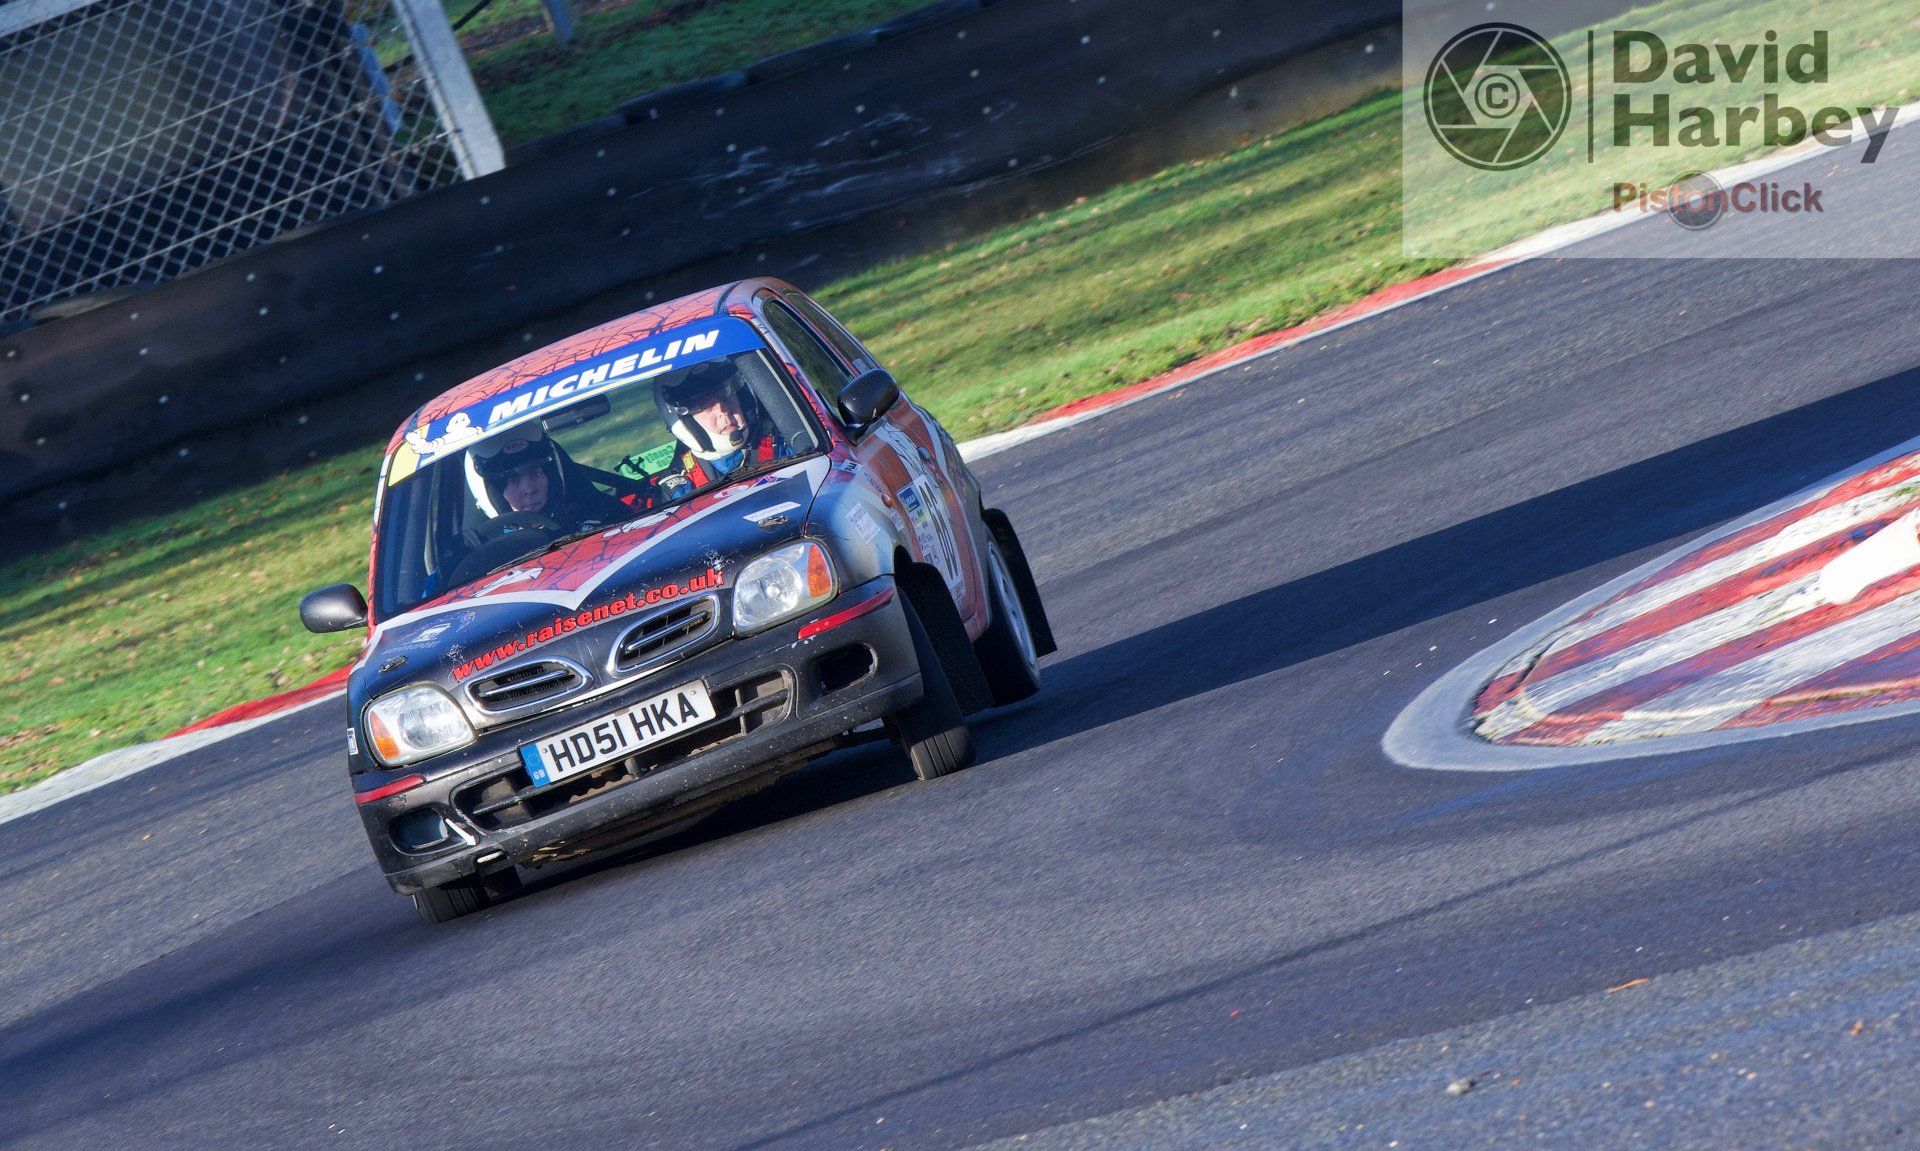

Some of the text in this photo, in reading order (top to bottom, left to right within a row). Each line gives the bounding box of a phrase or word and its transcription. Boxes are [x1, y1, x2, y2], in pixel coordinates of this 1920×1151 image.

[487, 329, 719, 425] MICHELIN
[453, 568, 725, 681] www.raisenet.co.uk
[548, 691, 699, 773] HD51 HKA
